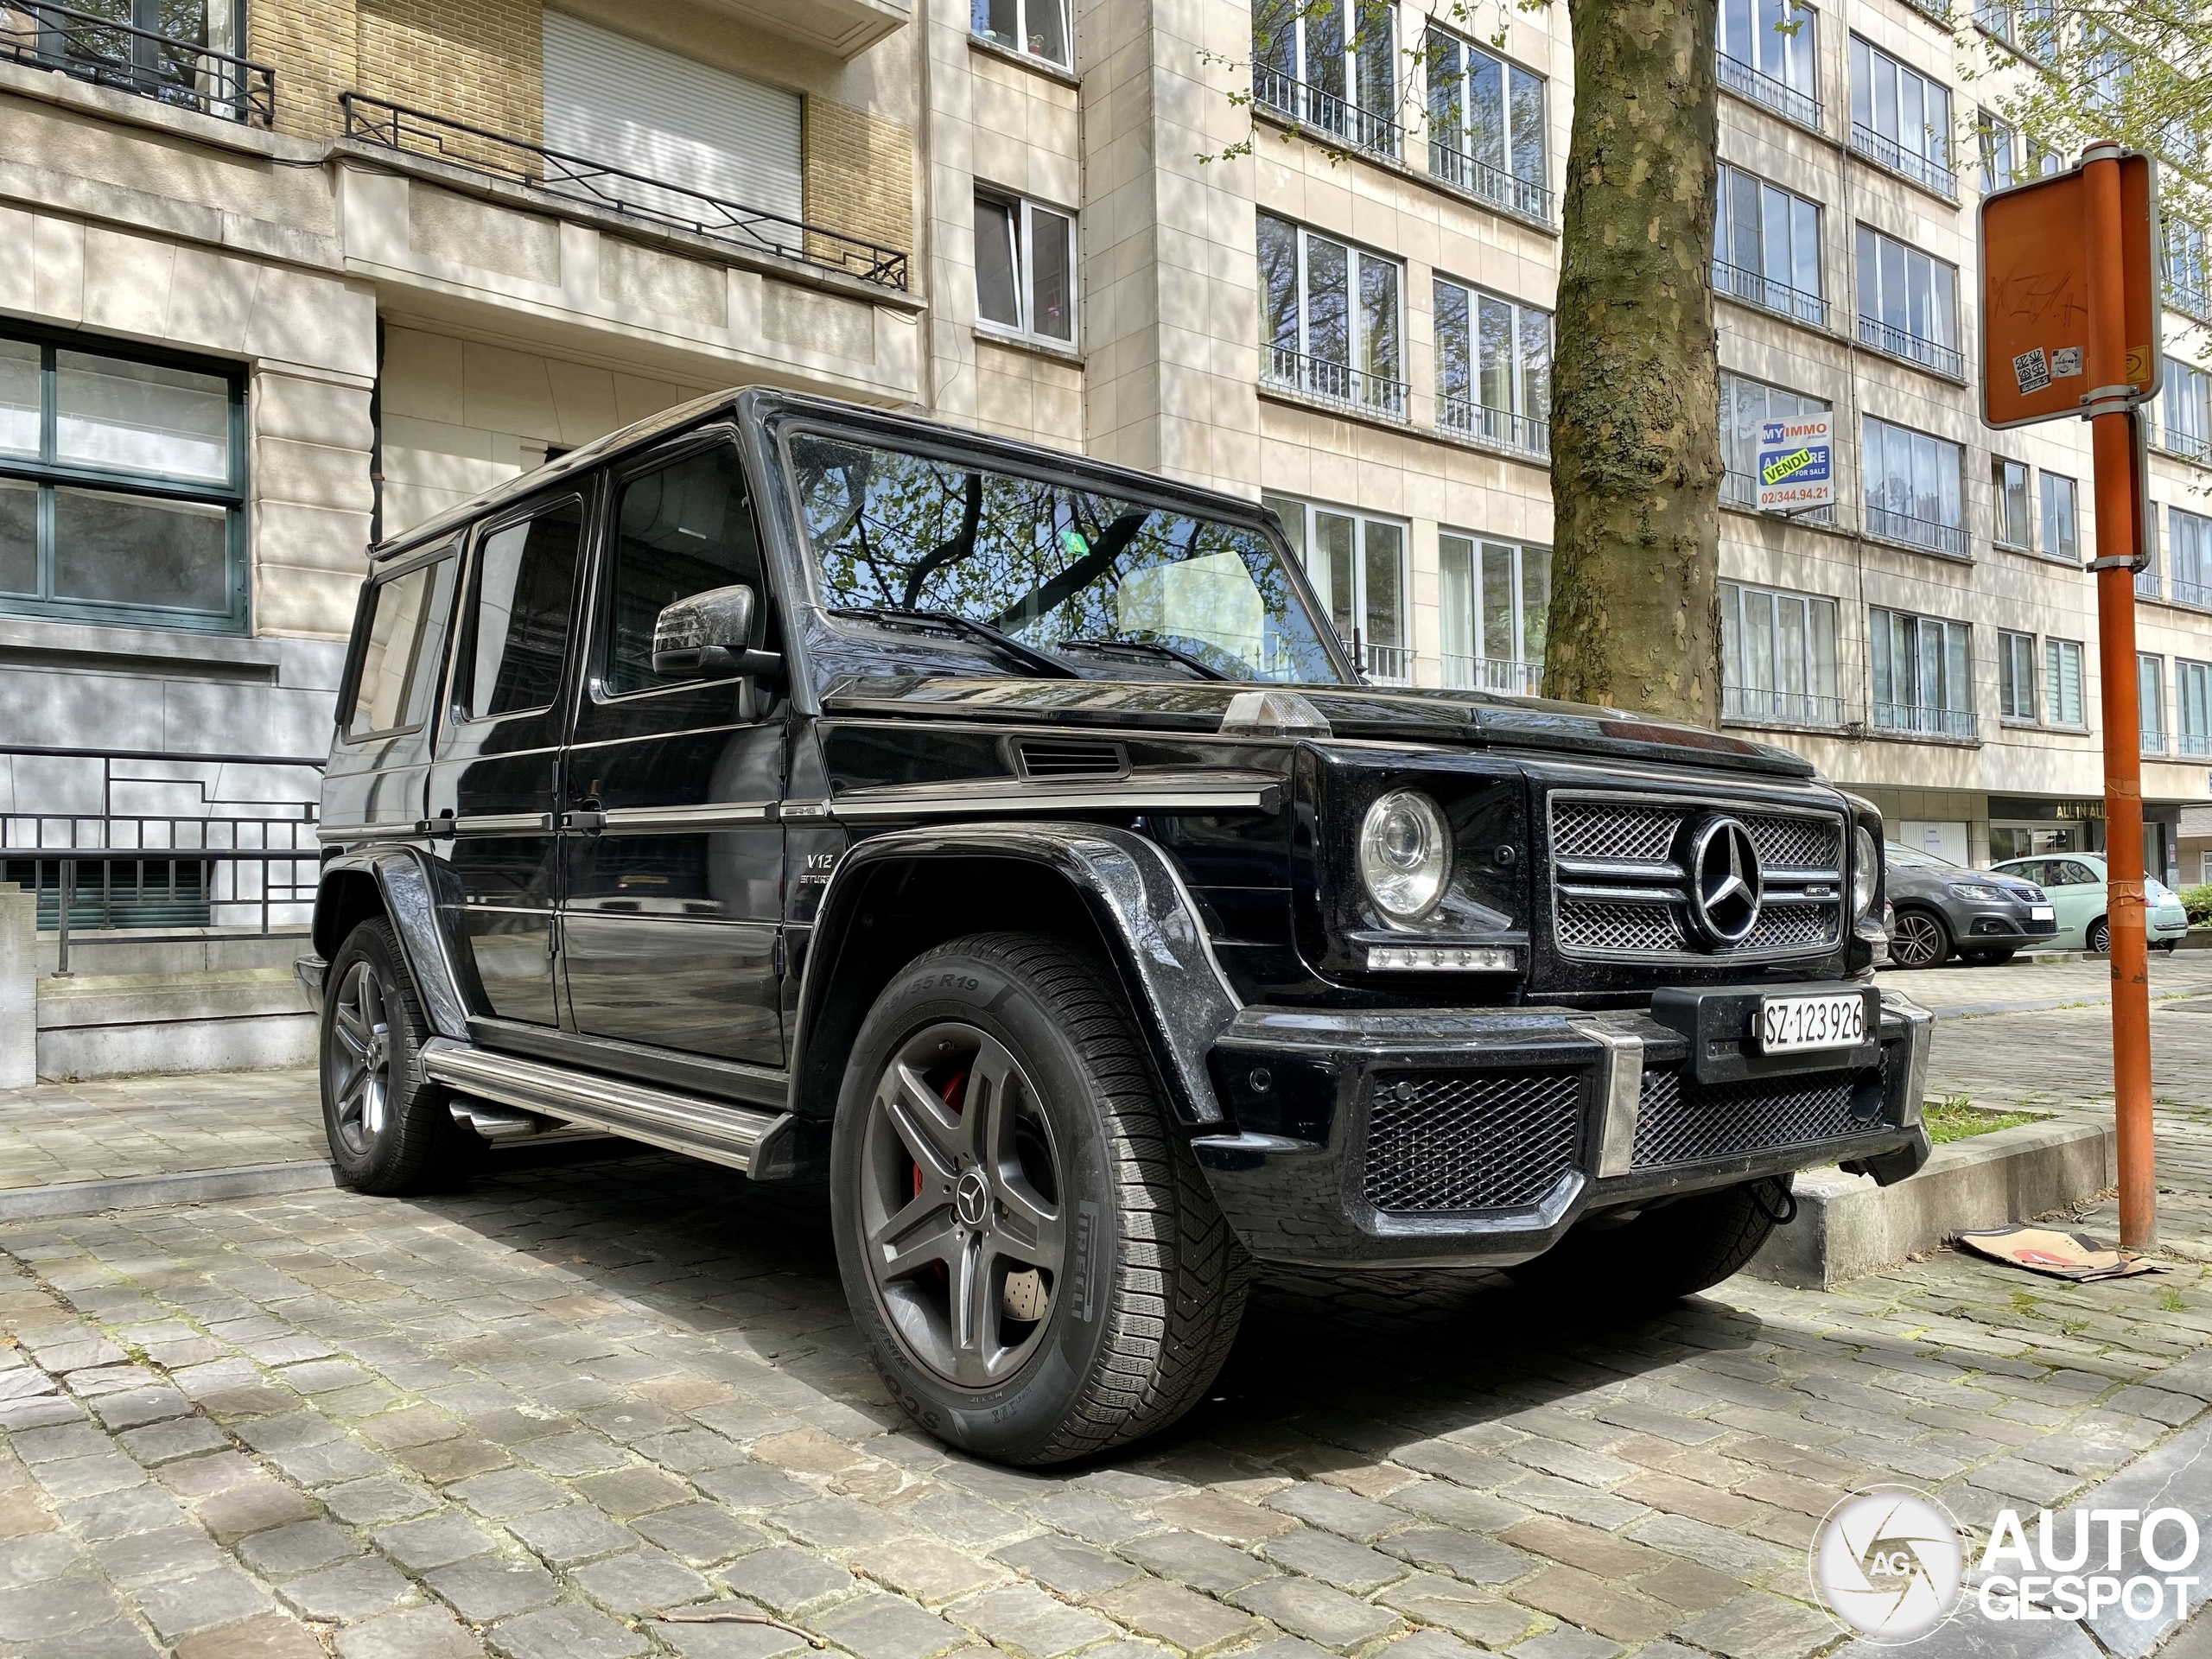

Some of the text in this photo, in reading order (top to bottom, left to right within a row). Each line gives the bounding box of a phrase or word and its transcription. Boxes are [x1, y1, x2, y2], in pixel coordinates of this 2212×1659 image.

[1765, 450, 1811, 481] VENDU
[1809, 467, 1826, 476] SALE
[1762, 486, 1828, 505] 02/344.94.21
[2056, 801, 2074, 819] ALL
[807, 854, 834, 869] V12
[1071, 1198, 1101, 1322] PIRELLI
